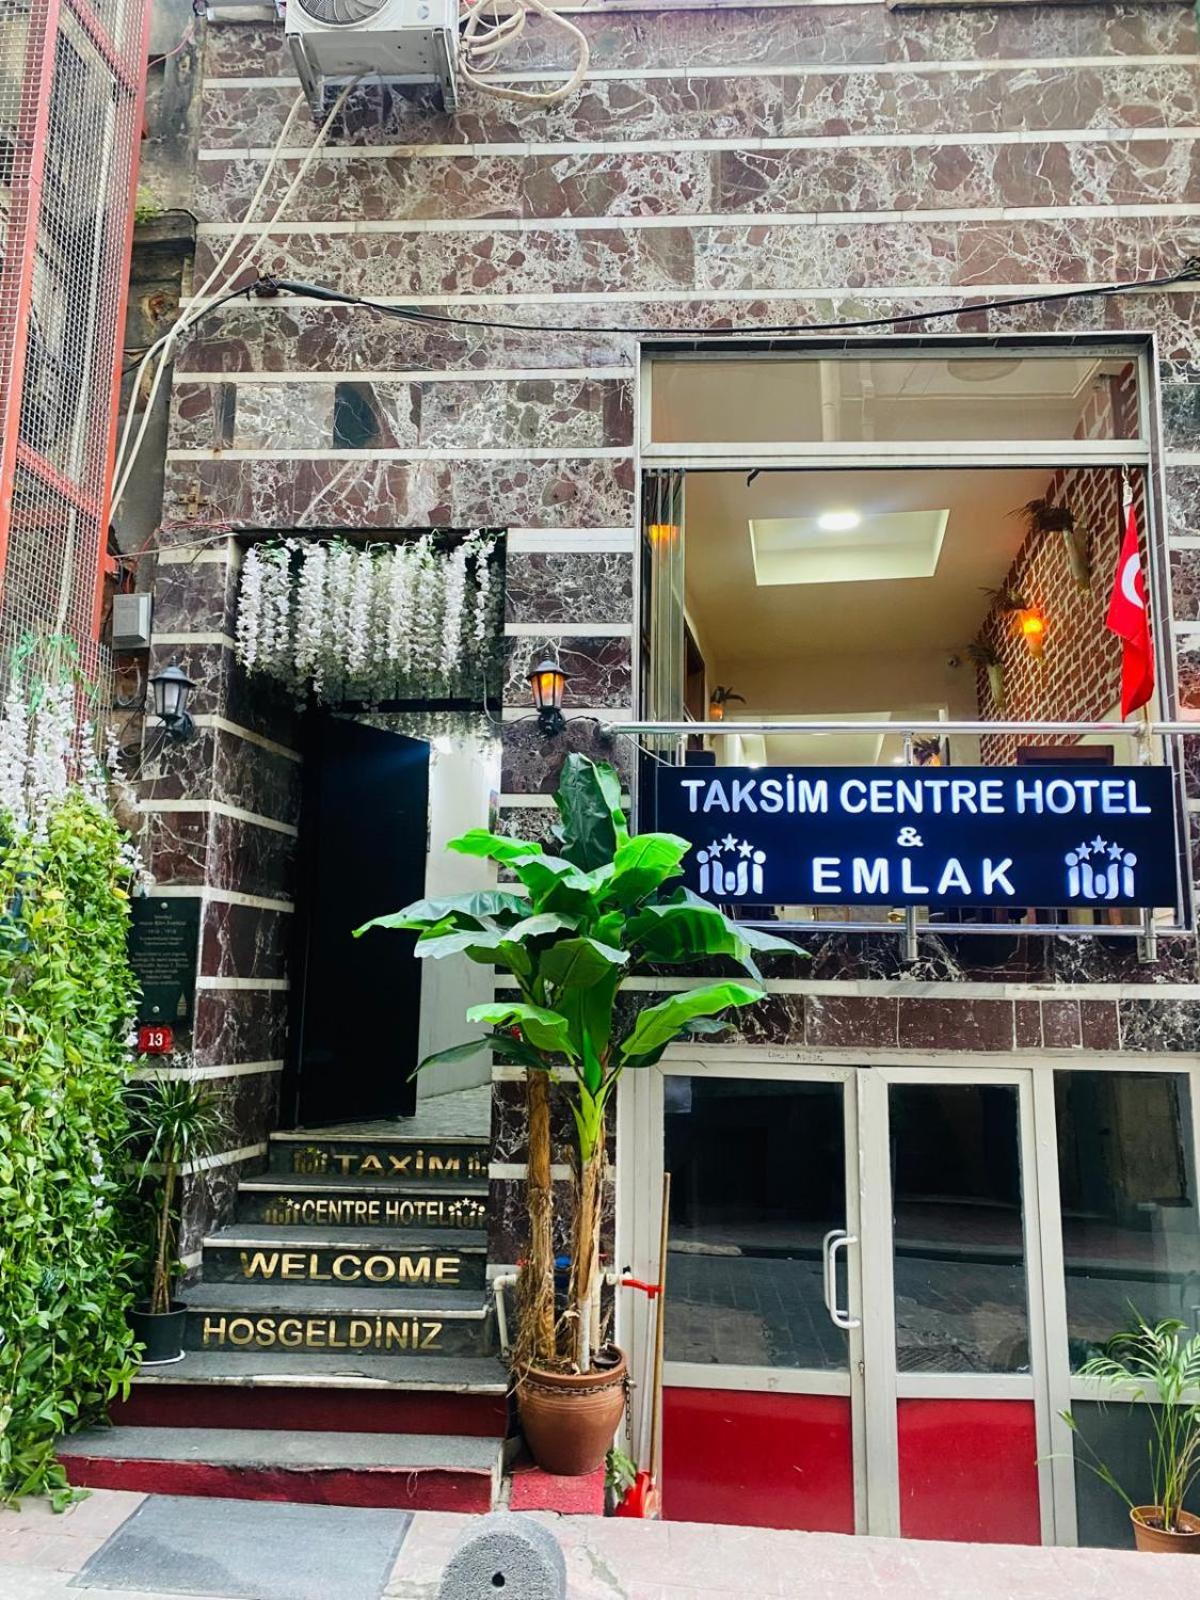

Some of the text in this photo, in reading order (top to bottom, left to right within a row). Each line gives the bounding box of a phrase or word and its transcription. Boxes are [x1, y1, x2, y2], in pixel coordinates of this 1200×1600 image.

[681, 774, 1152, 814] TAKSİM CENTRE HOTEL
[897, 827, 924, 847] &
[812, 857, 1016, 895] EMLAK
[148, 1033, 163, 1046] 13
[333, 1150, 461, 1177] TAXİM
[302, 1200, 448, 1227] CENTRE HOTEL
[240, 1252, 461, 1284] WELCOME
